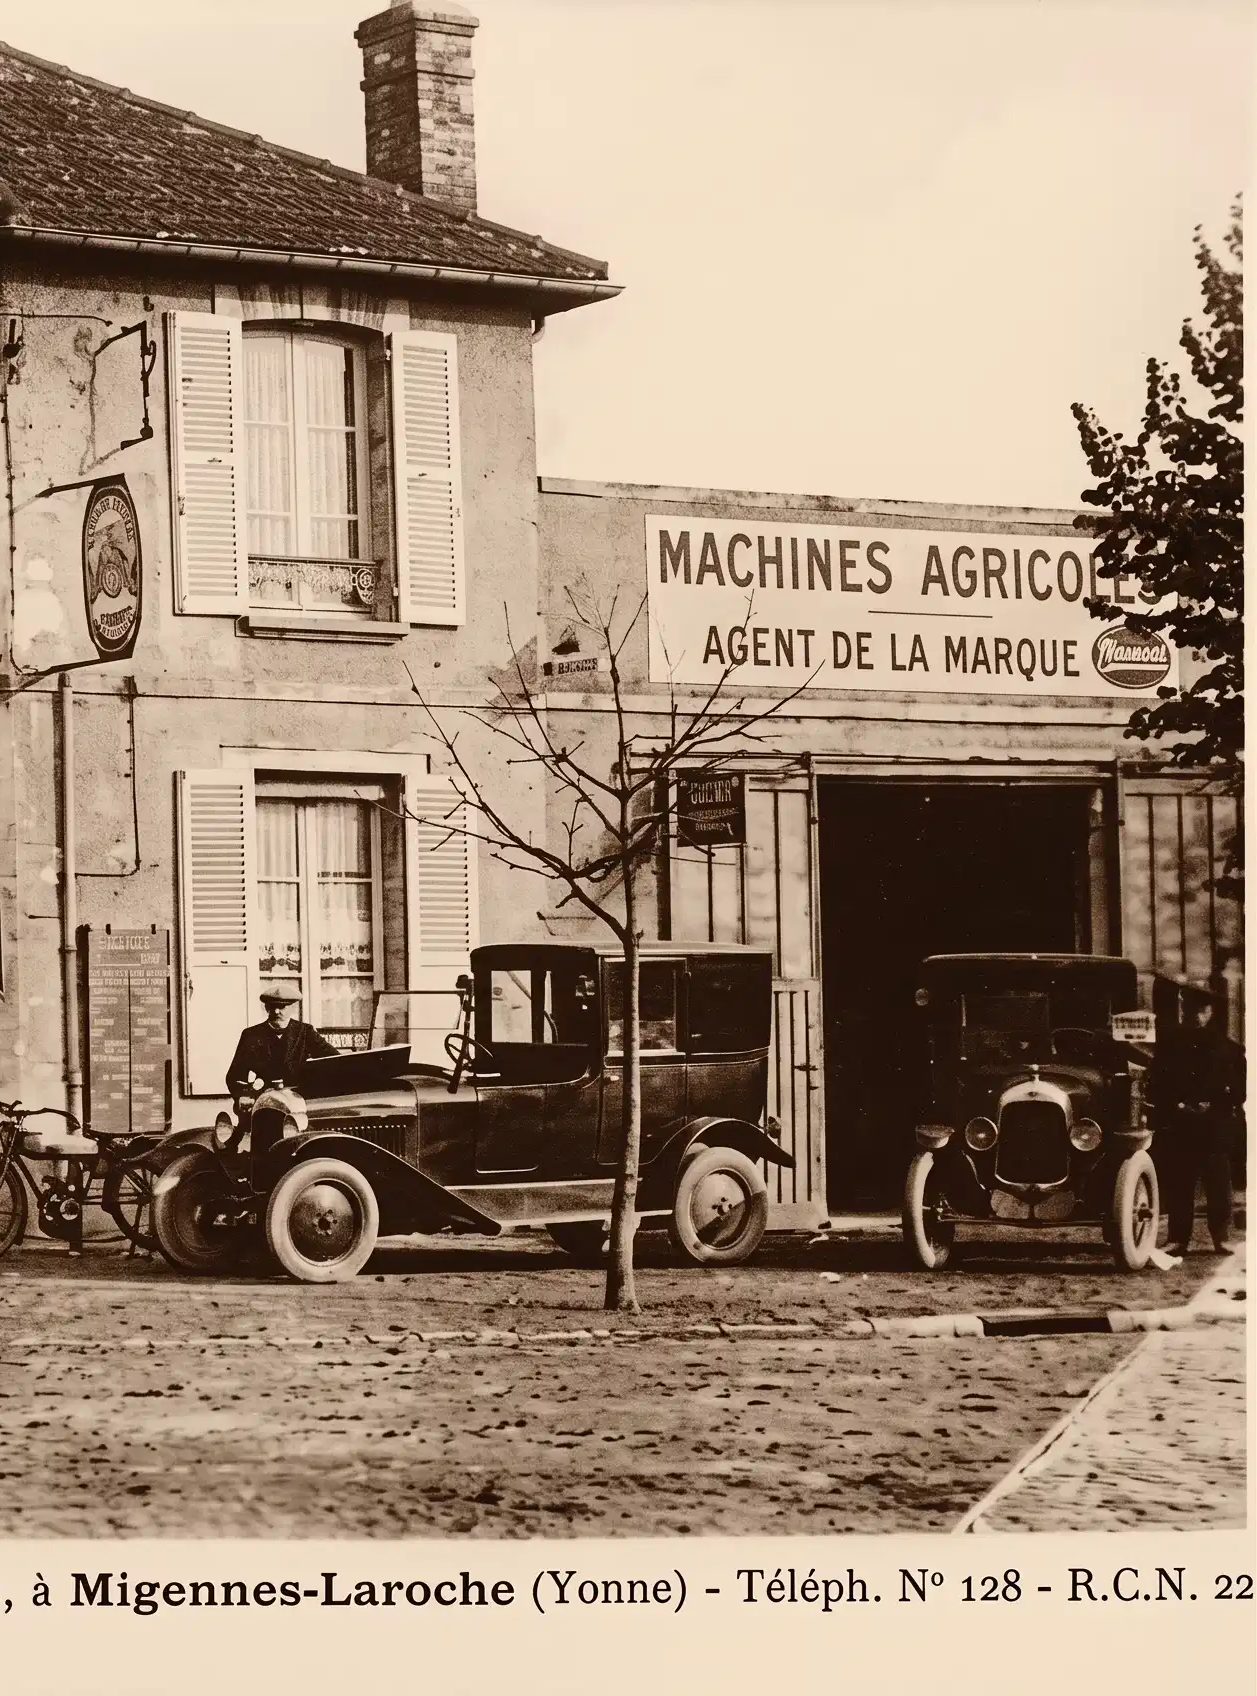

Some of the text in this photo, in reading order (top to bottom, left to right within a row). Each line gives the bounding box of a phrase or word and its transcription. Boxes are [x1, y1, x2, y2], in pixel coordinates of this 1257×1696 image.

[658, 529, 893, 595] MACHINES
[703, 624, 1080, 681] AGENT DE LA MARQUE
